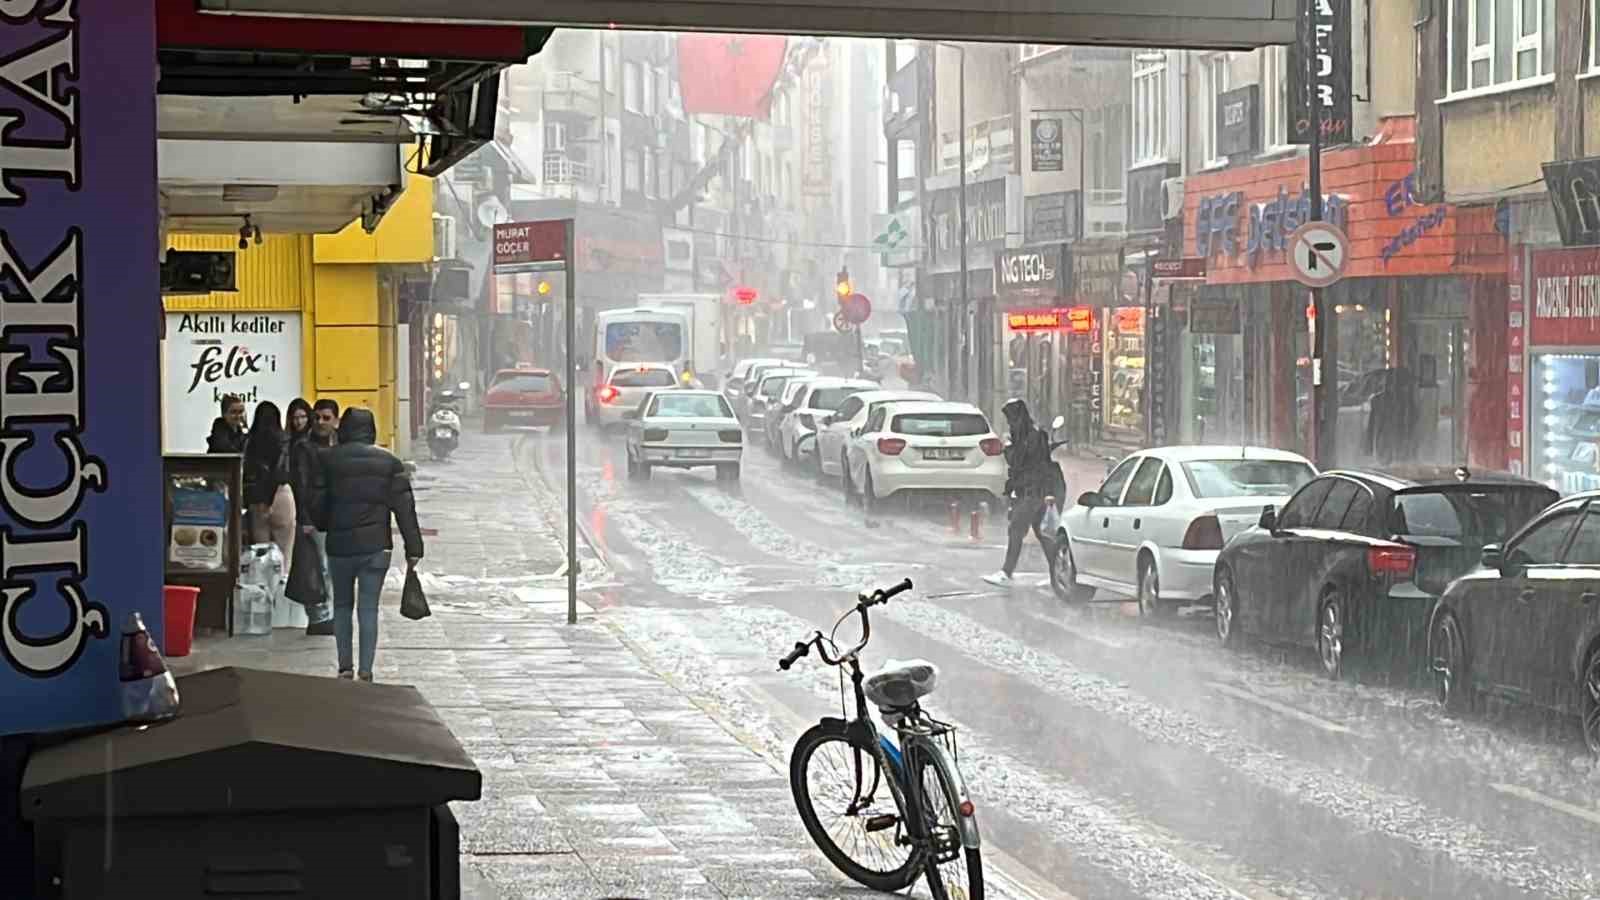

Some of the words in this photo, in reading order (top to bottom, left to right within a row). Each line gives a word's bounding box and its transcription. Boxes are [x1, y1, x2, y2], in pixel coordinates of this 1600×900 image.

[496, 227, 532, 240] MURAT
[178, 312, 225, 333] Akıllı
[231, 313, 286, 333] kediler
[213, 386, 257, 403] kar!
